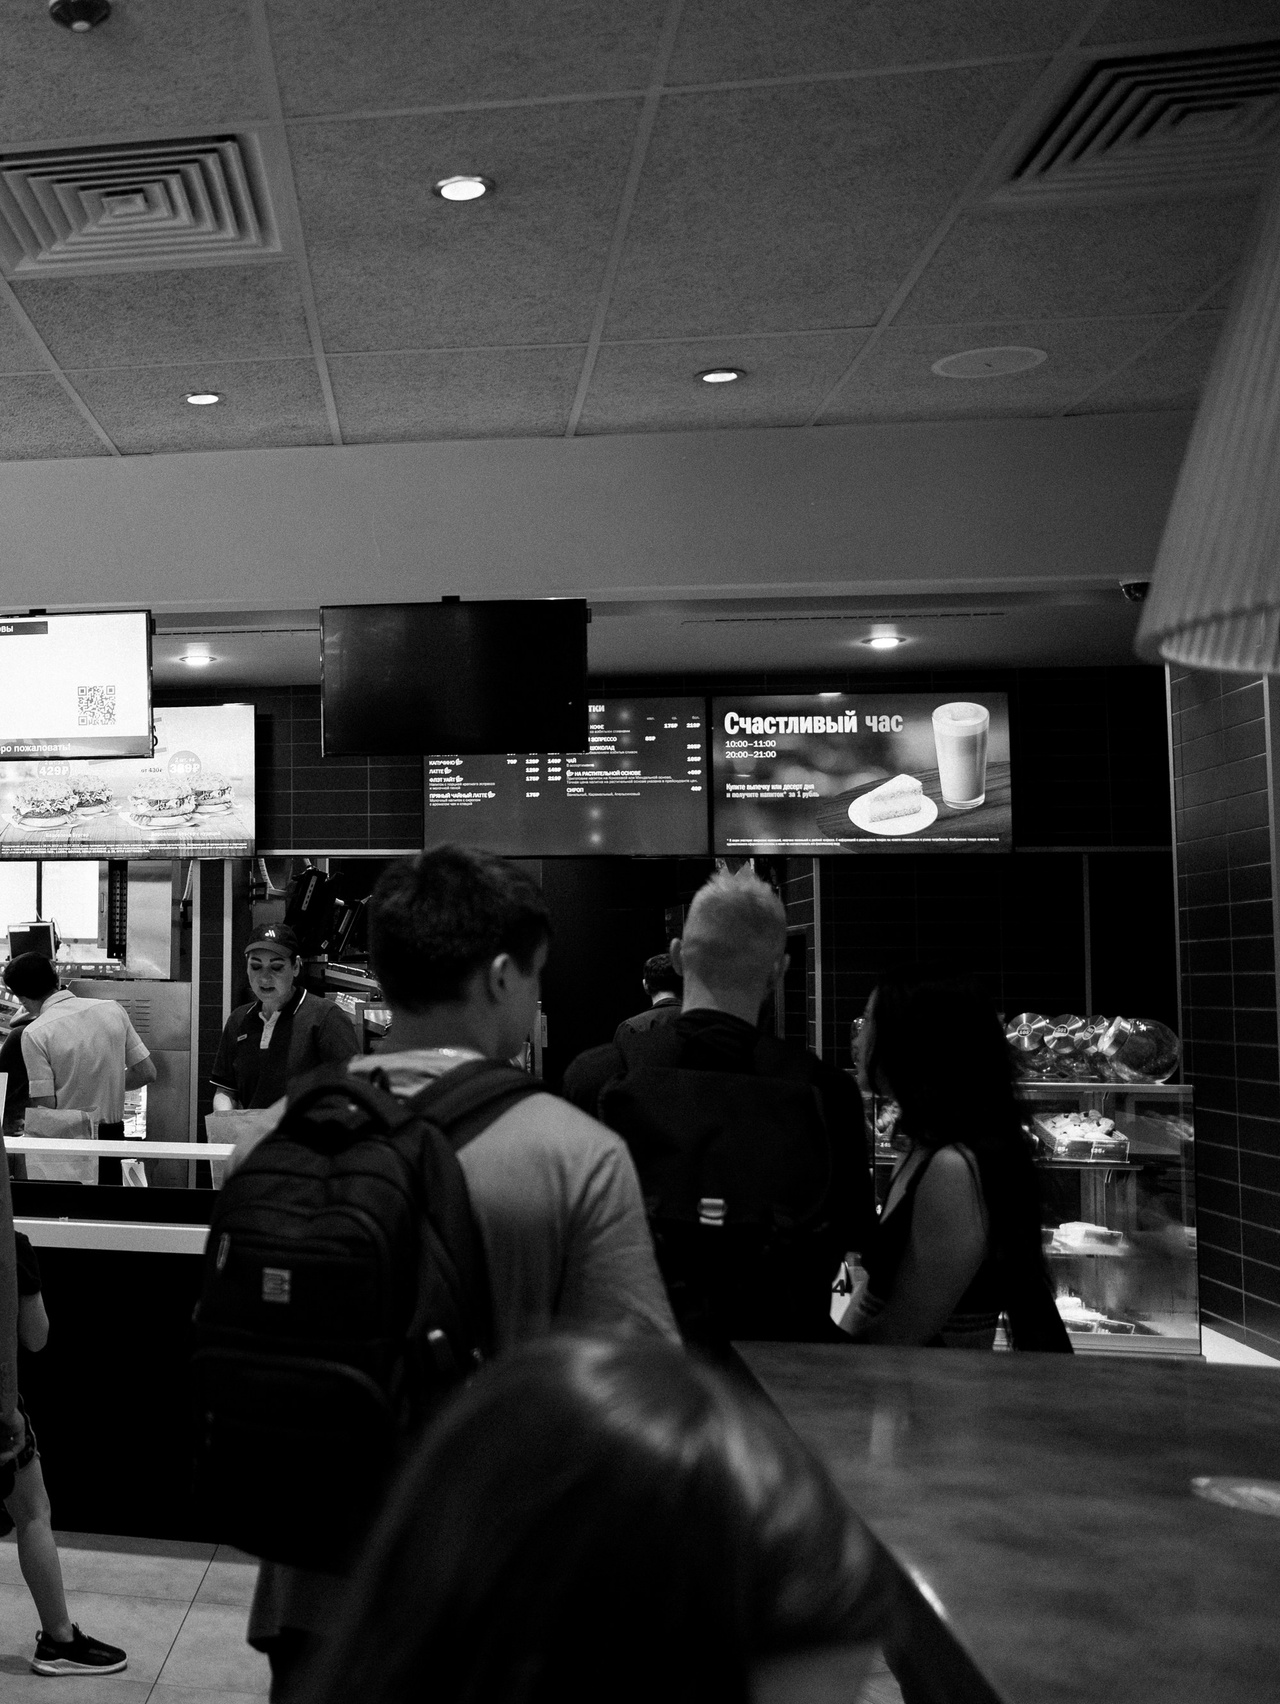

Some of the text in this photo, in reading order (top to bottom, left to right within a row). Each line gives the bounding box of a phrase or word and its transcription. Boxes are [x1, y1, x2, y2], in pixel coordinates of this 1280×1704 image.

[724, 710, 904, 735] Счастливый час
[14, 743, 70, 753] пожаловать!
[725, 739, 777, 748] 10:00–11:00
[725, 751, 777, 759] 20:00–21:00
[726, 783, 746, 792] Купите
[783, 783, 803, 791] десерт
[803, 783, 815, 791] дня
[802, 790, 820, 798] рубль
